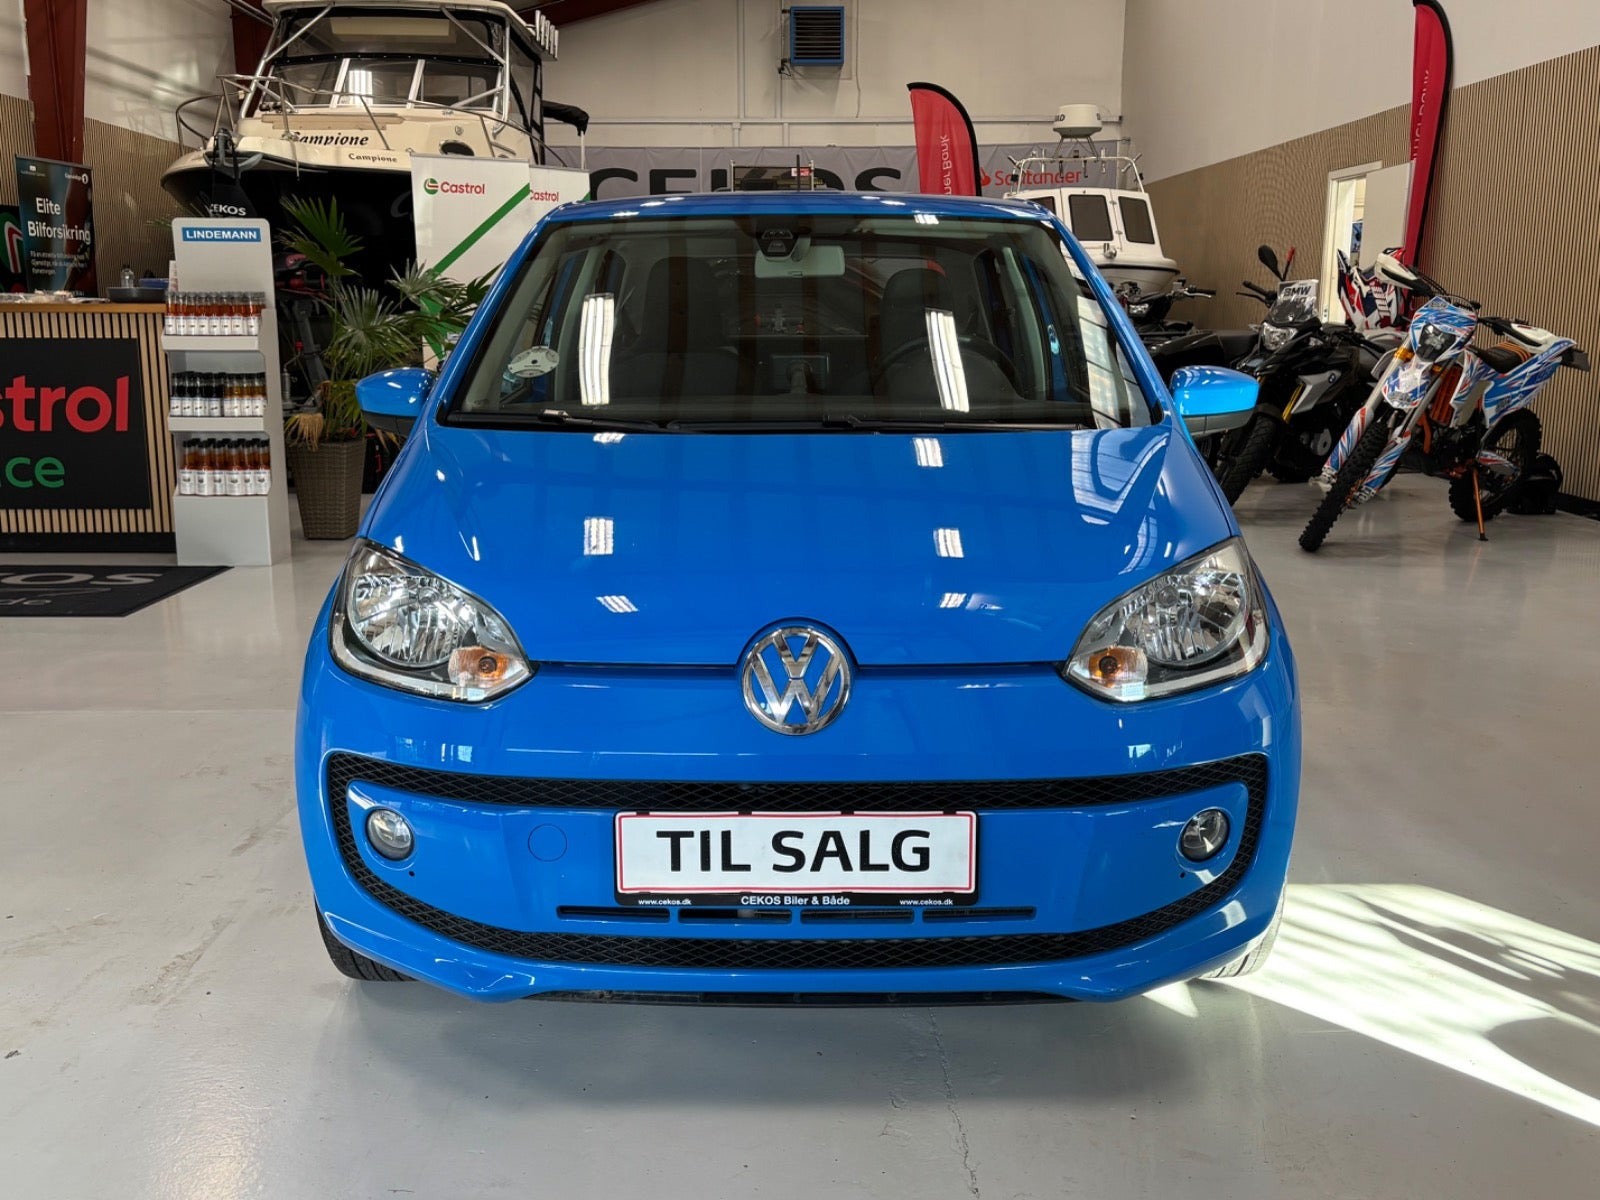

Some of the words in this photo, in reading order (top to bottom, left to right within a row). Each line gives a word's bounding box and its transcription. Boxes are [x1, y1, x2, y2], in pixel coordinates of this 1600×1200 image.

[348, 152, 398, 163] Campione
[994, 170, 1082, 186] Satander
[440, 181, 485, 195] Castrol
[35, 197, 61, 215] Elite
[27, 221, 91, 245] Bilforsikring
[185, 230, 257, 239] LINDEMANN
[0, 375, 129, 433] trol
[0, 456, 65, 488] ce
[0, 572, 163, 585] OS
[656, 829, 752, 872] TIL
[771, 829, 931, 873] SALG
[638, 898, 692, 906] www.cekos.dk
[740, 895, 781, 905] CEKOS
[783, 895, 809, 905] Biler
[811, 896, 820, 905] &
[822, 895, 850, 905] Både
[899, 898, 953, 906] www.cekos.dk
